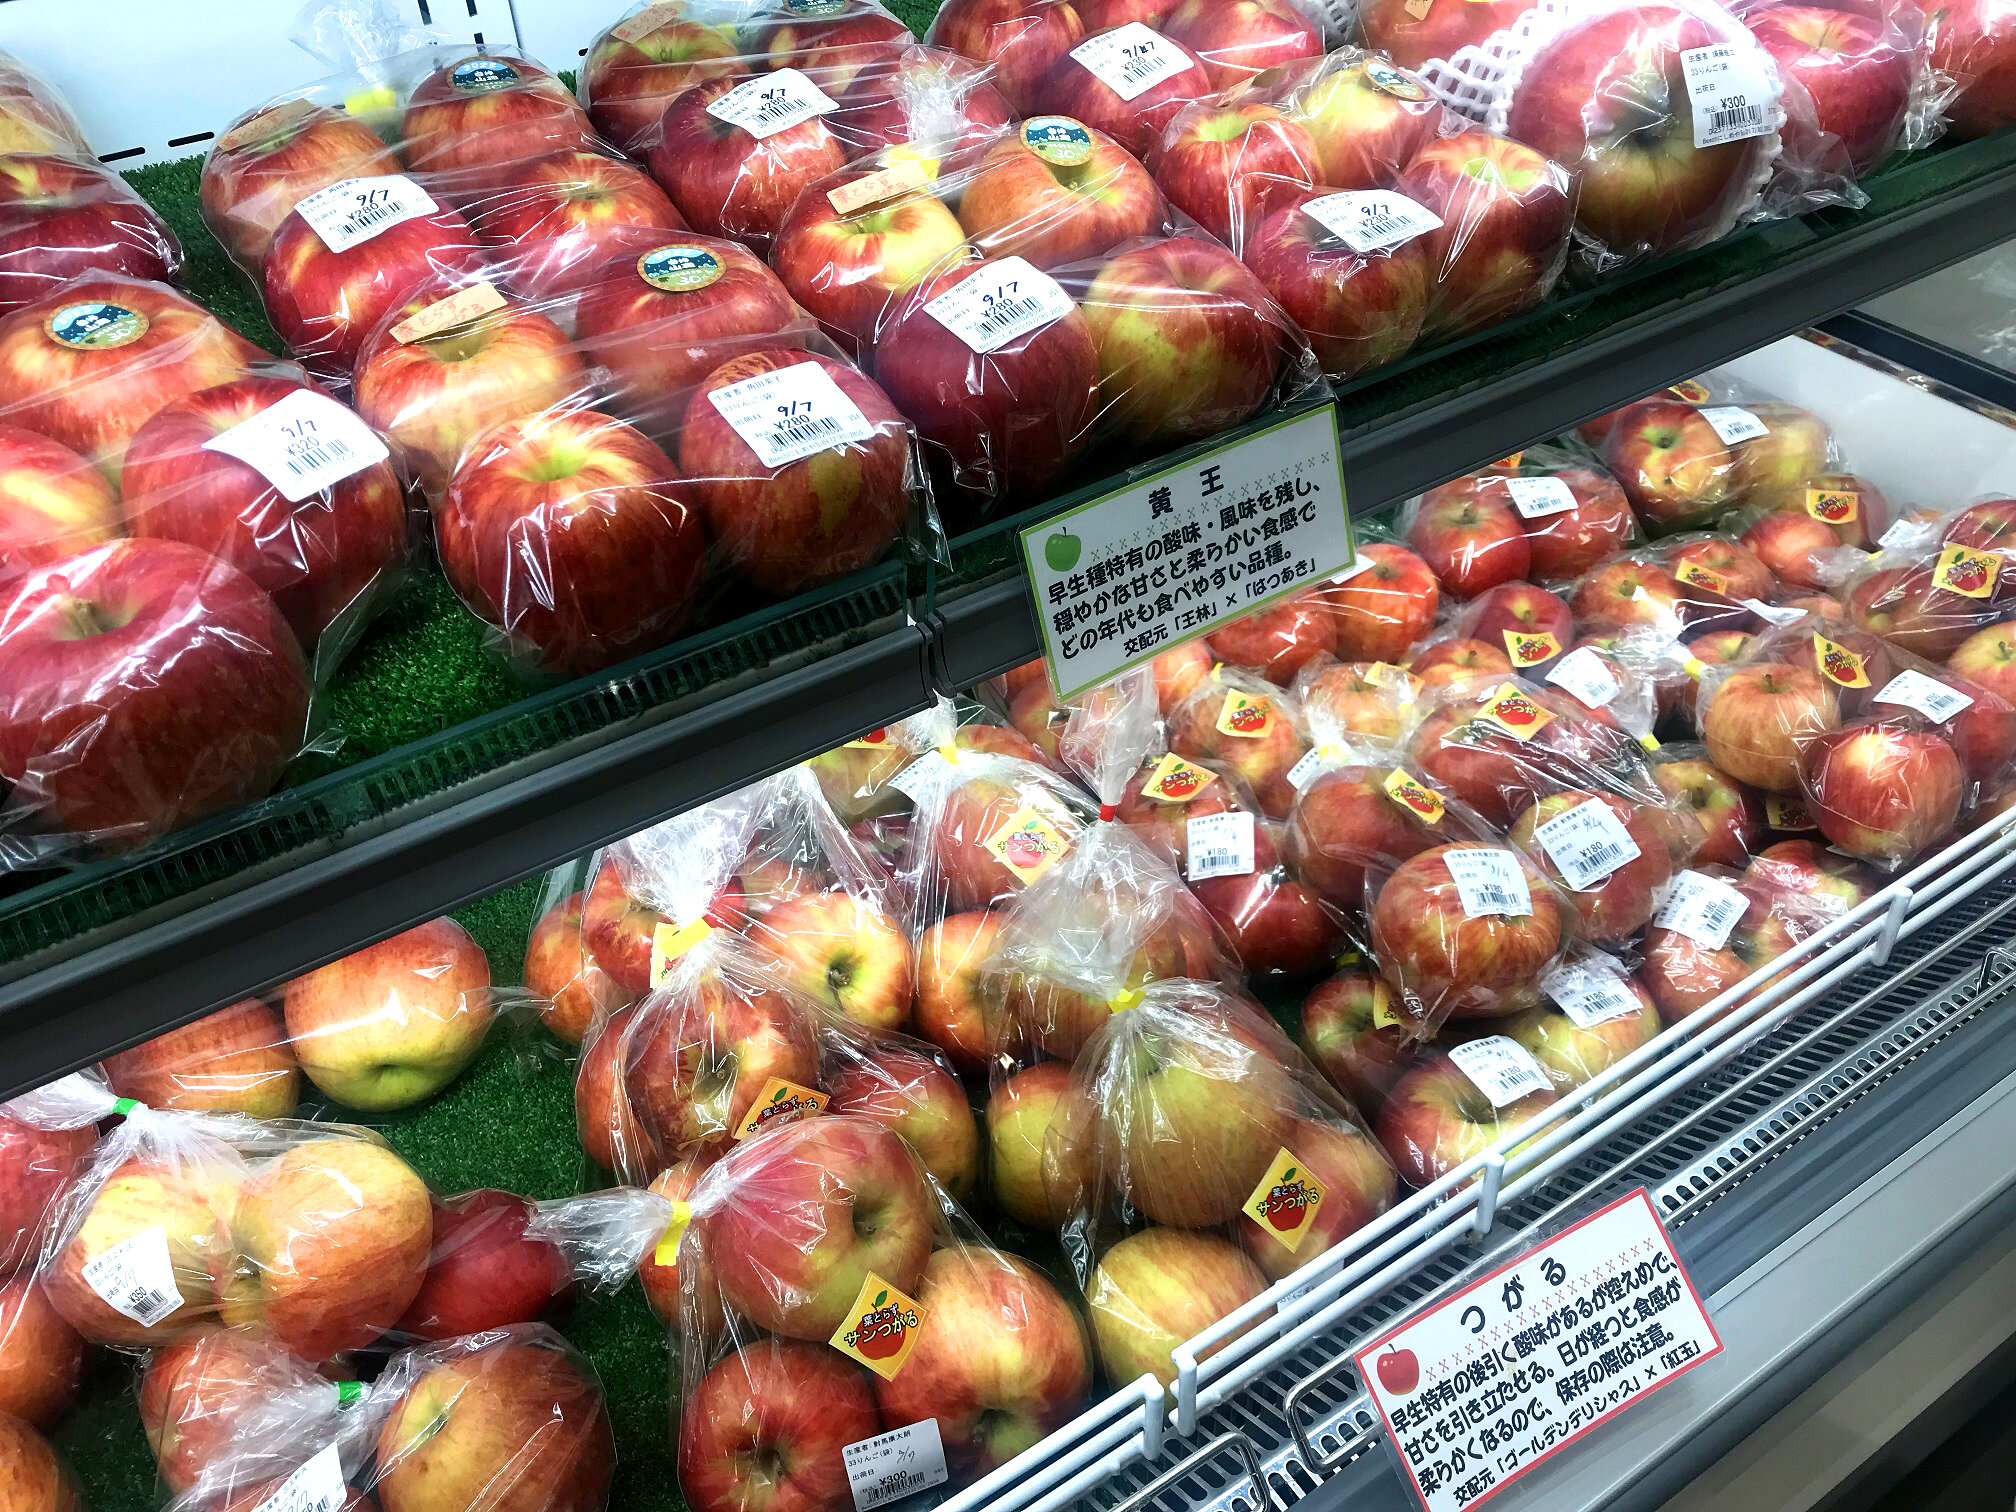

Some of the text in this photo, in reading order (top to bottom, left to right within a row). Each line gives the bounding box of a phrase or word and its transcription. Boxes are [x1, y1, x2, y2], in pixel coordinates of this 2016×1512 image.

[757, 96, 786, 111] ¥280
[1720, 95, 1746, 110] ¥300
[356, 189, 389, 207] 9/7
[346, 202, 380, 221] ¥280
[1358, 213, 1389, 228] ¥230
[982, 281, 1019, 306] 9/7
[980, 297, 1014, 319] ¥280
[777, 401, 812, 417] 9/7
[281, 419, 317, 438] 9/7
[773, 414, 811, 431] ¥280
[284, 435, 321, 457] ¥320
[1048, 477, 1320, 606] 早生種特有の酸味・風味を残し、
[1052, 504, 1317, 635] 穏やかな甘さと柔らかい食感で
[1060, 540, 1294, 661] どの年代も食べやすい品種。
[997, 840, 1061, 854] サンつがる
[1207, 847, 1228, 857] ¥180
[1579, 841, 1604, 858] ¥180
[1482, 883, 1504, 894] ¥180
[1700, 901, 1718, 919] ¥180
[1582, 991, 1606, 1003] ¥180
[1498, 1065, 1521, 1078] ¥180
[761, 1094, 799, 1118] 葉とらず
[1272, 1180, 1305, 1198] 葉とらず
[1256, 1187, 1319, 1218] サンつがる
[127, 1286, 147, 1304] ¥350
[862, 1302, 899, 1327] 葉とらず
[843, 1309, 918, 1348] サンつがる
[1390, 1250, 1678, 1435] 早生特有の後引く酸味があるが控えめで、
[878, 1470, 908, 1486] ¥300
